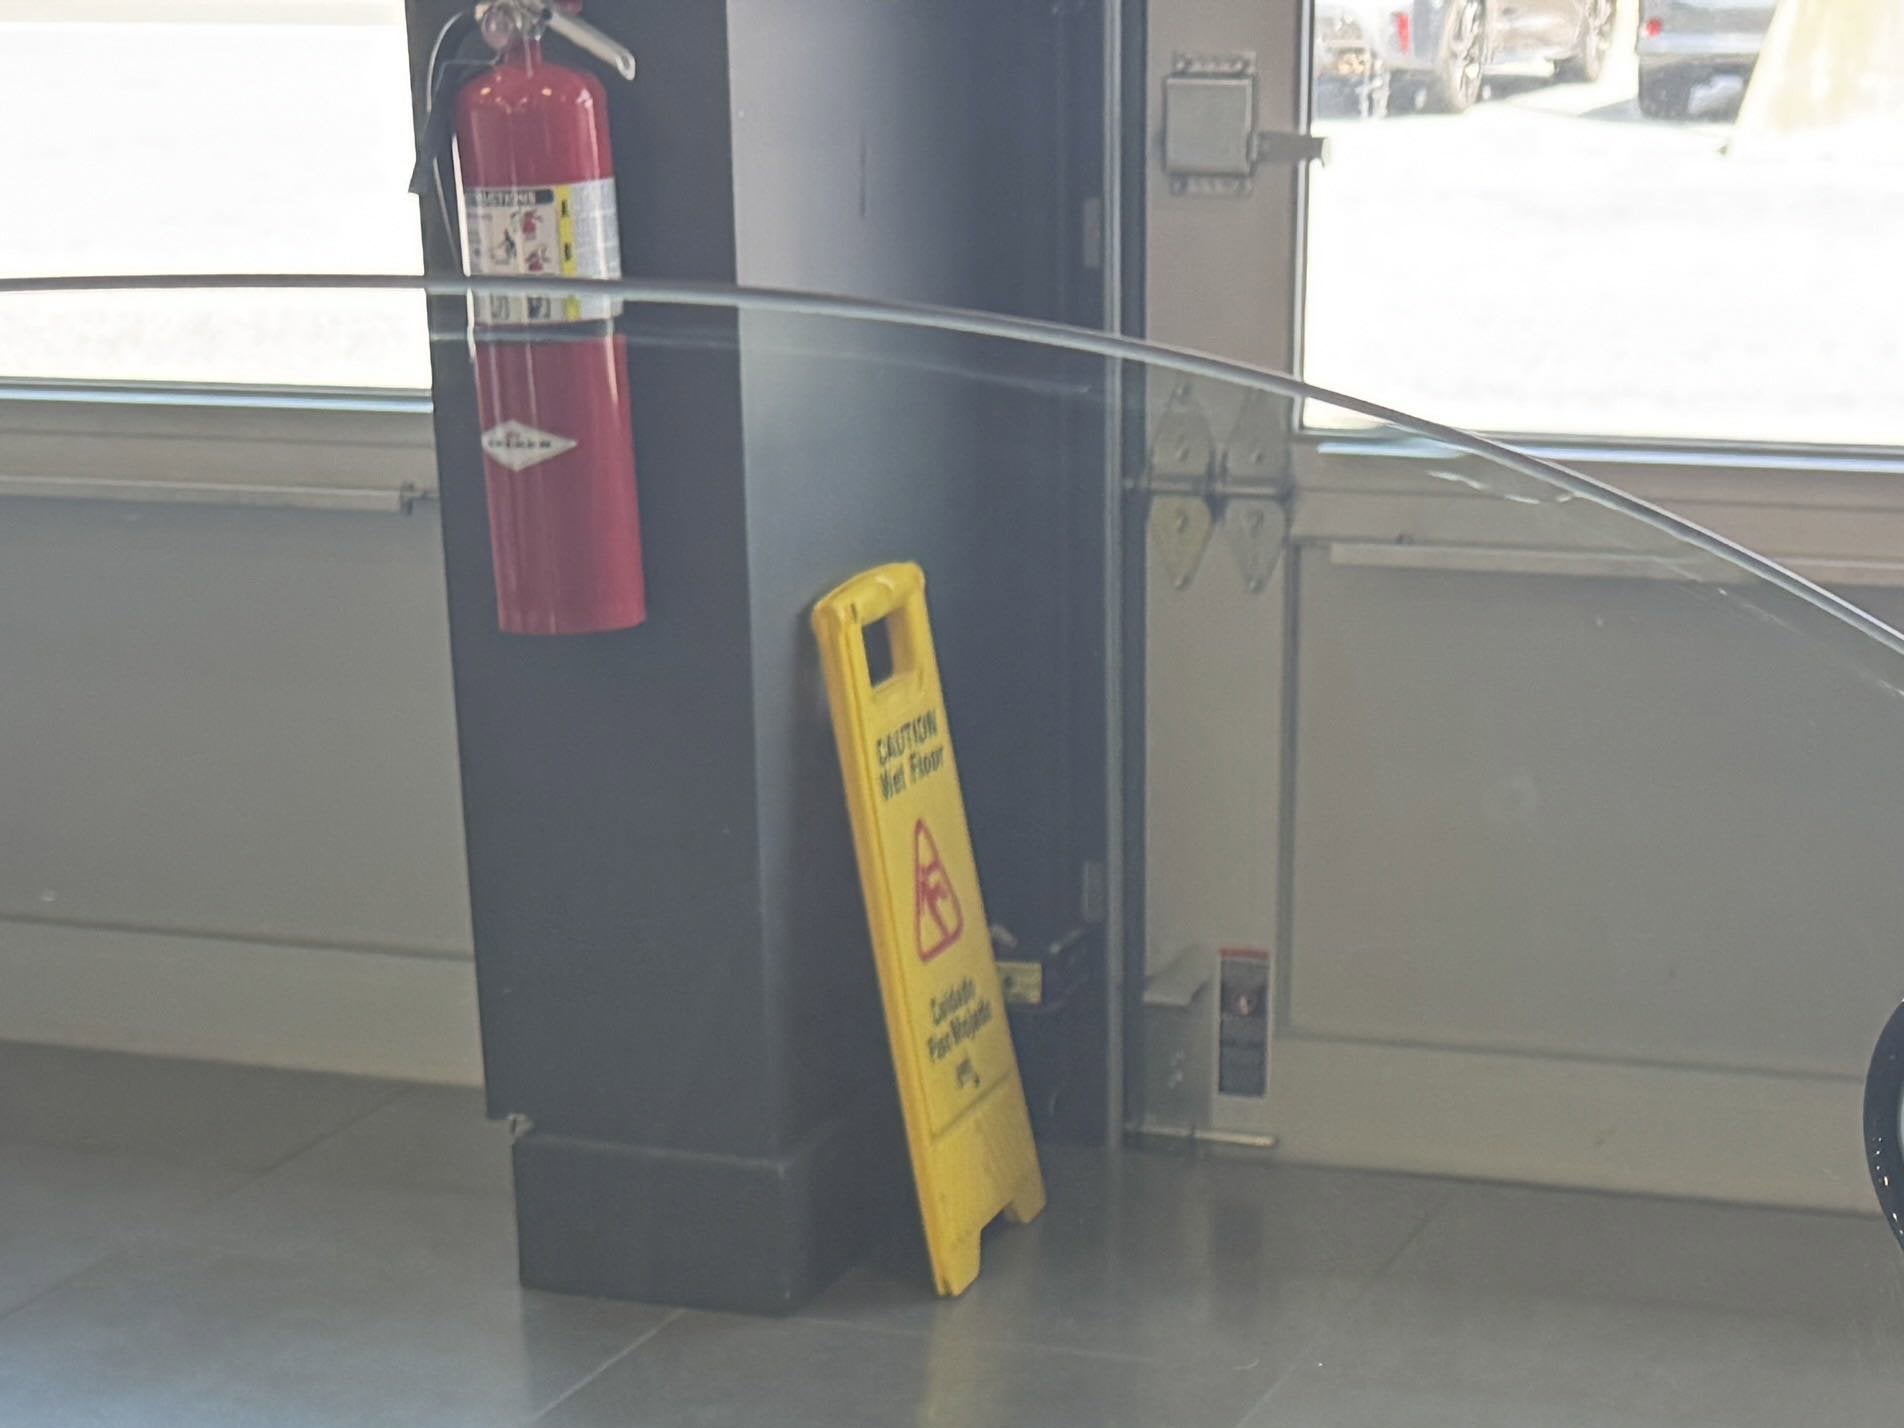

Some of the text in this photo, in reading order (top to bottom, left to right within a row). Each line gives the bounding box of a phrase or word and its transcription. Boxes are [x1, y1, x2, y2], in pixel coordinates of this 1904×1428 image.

[876, 708, 938, 766] CAUTION
[880, 745, 944, 801] Wet Floor
